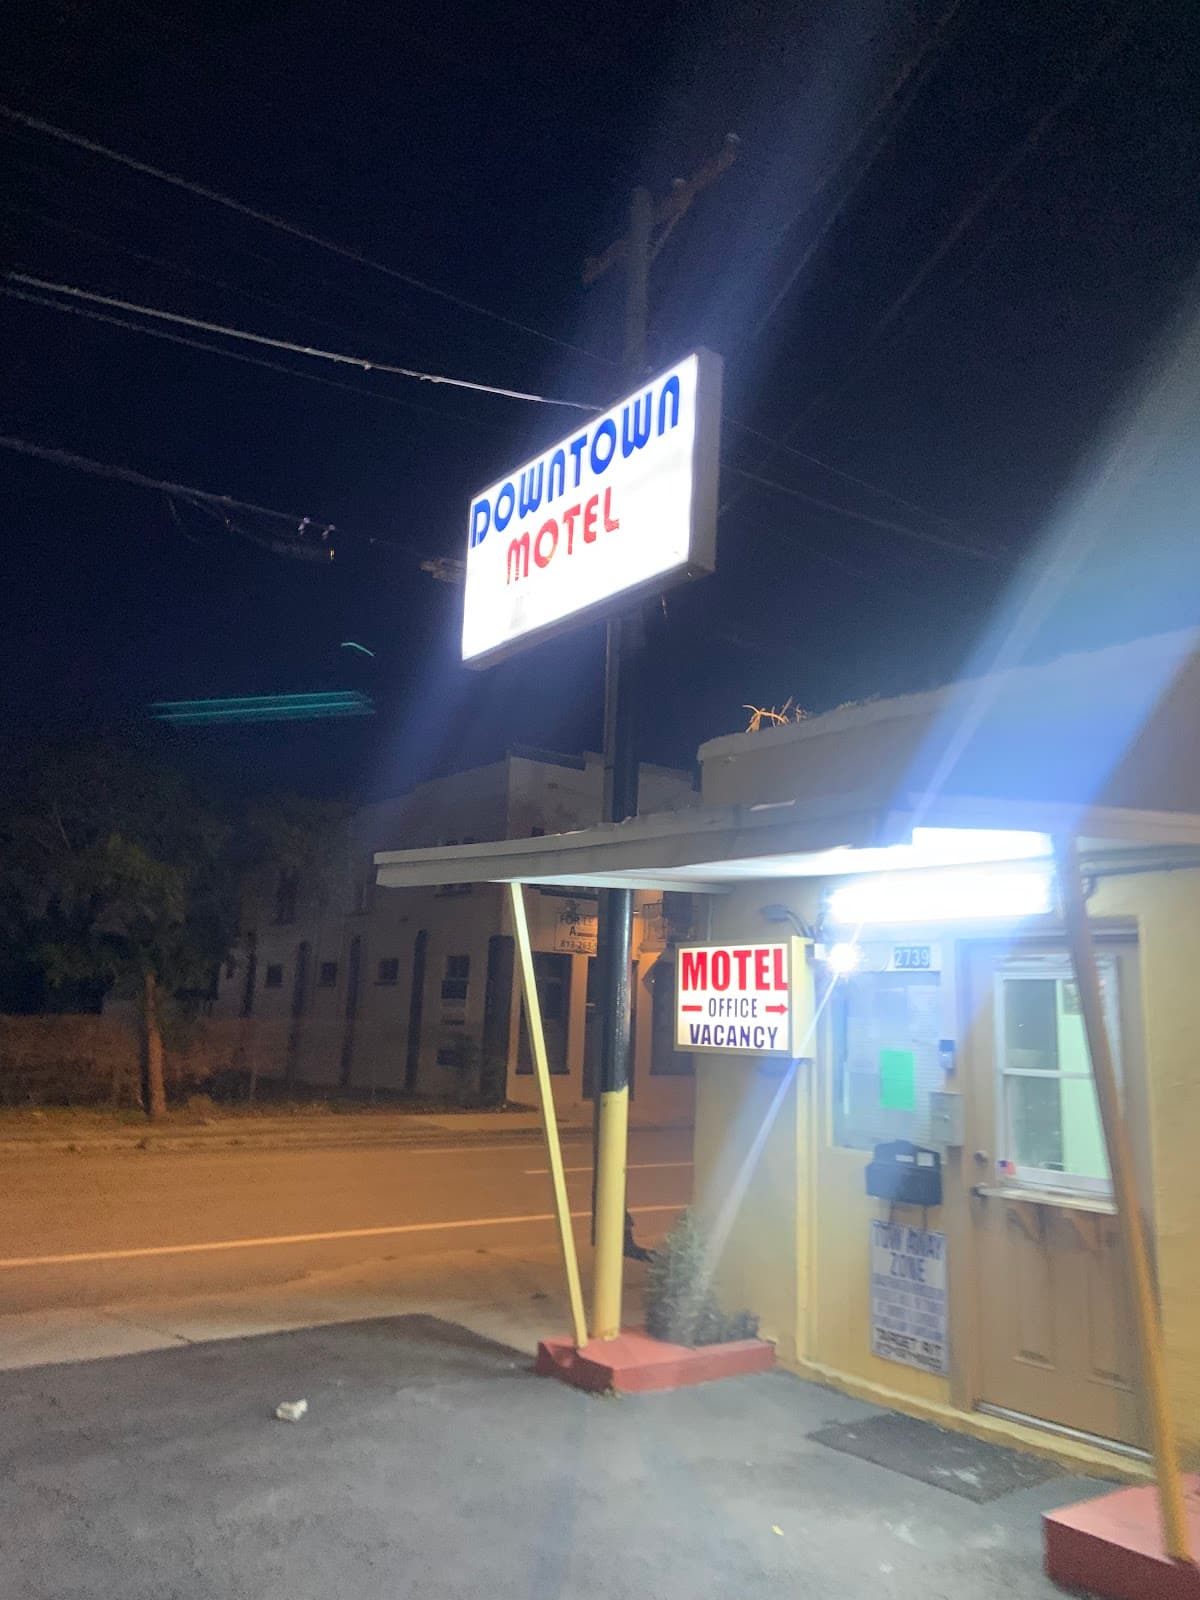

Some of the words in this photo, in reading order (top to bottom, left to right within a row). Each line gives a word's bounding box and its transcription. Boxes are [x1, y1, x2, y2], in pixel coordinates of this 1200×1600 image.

[470, 375, 680, 549] DOWNTOWN
[507, 486, 620, 585] MOTEL
[682, 948, 788, 992] MOTEL
[895, 948, 929, 967] 2739
[708, 997, 758, 1019] OFFICE
[689, 1023, 778, 1049] VACANCY
